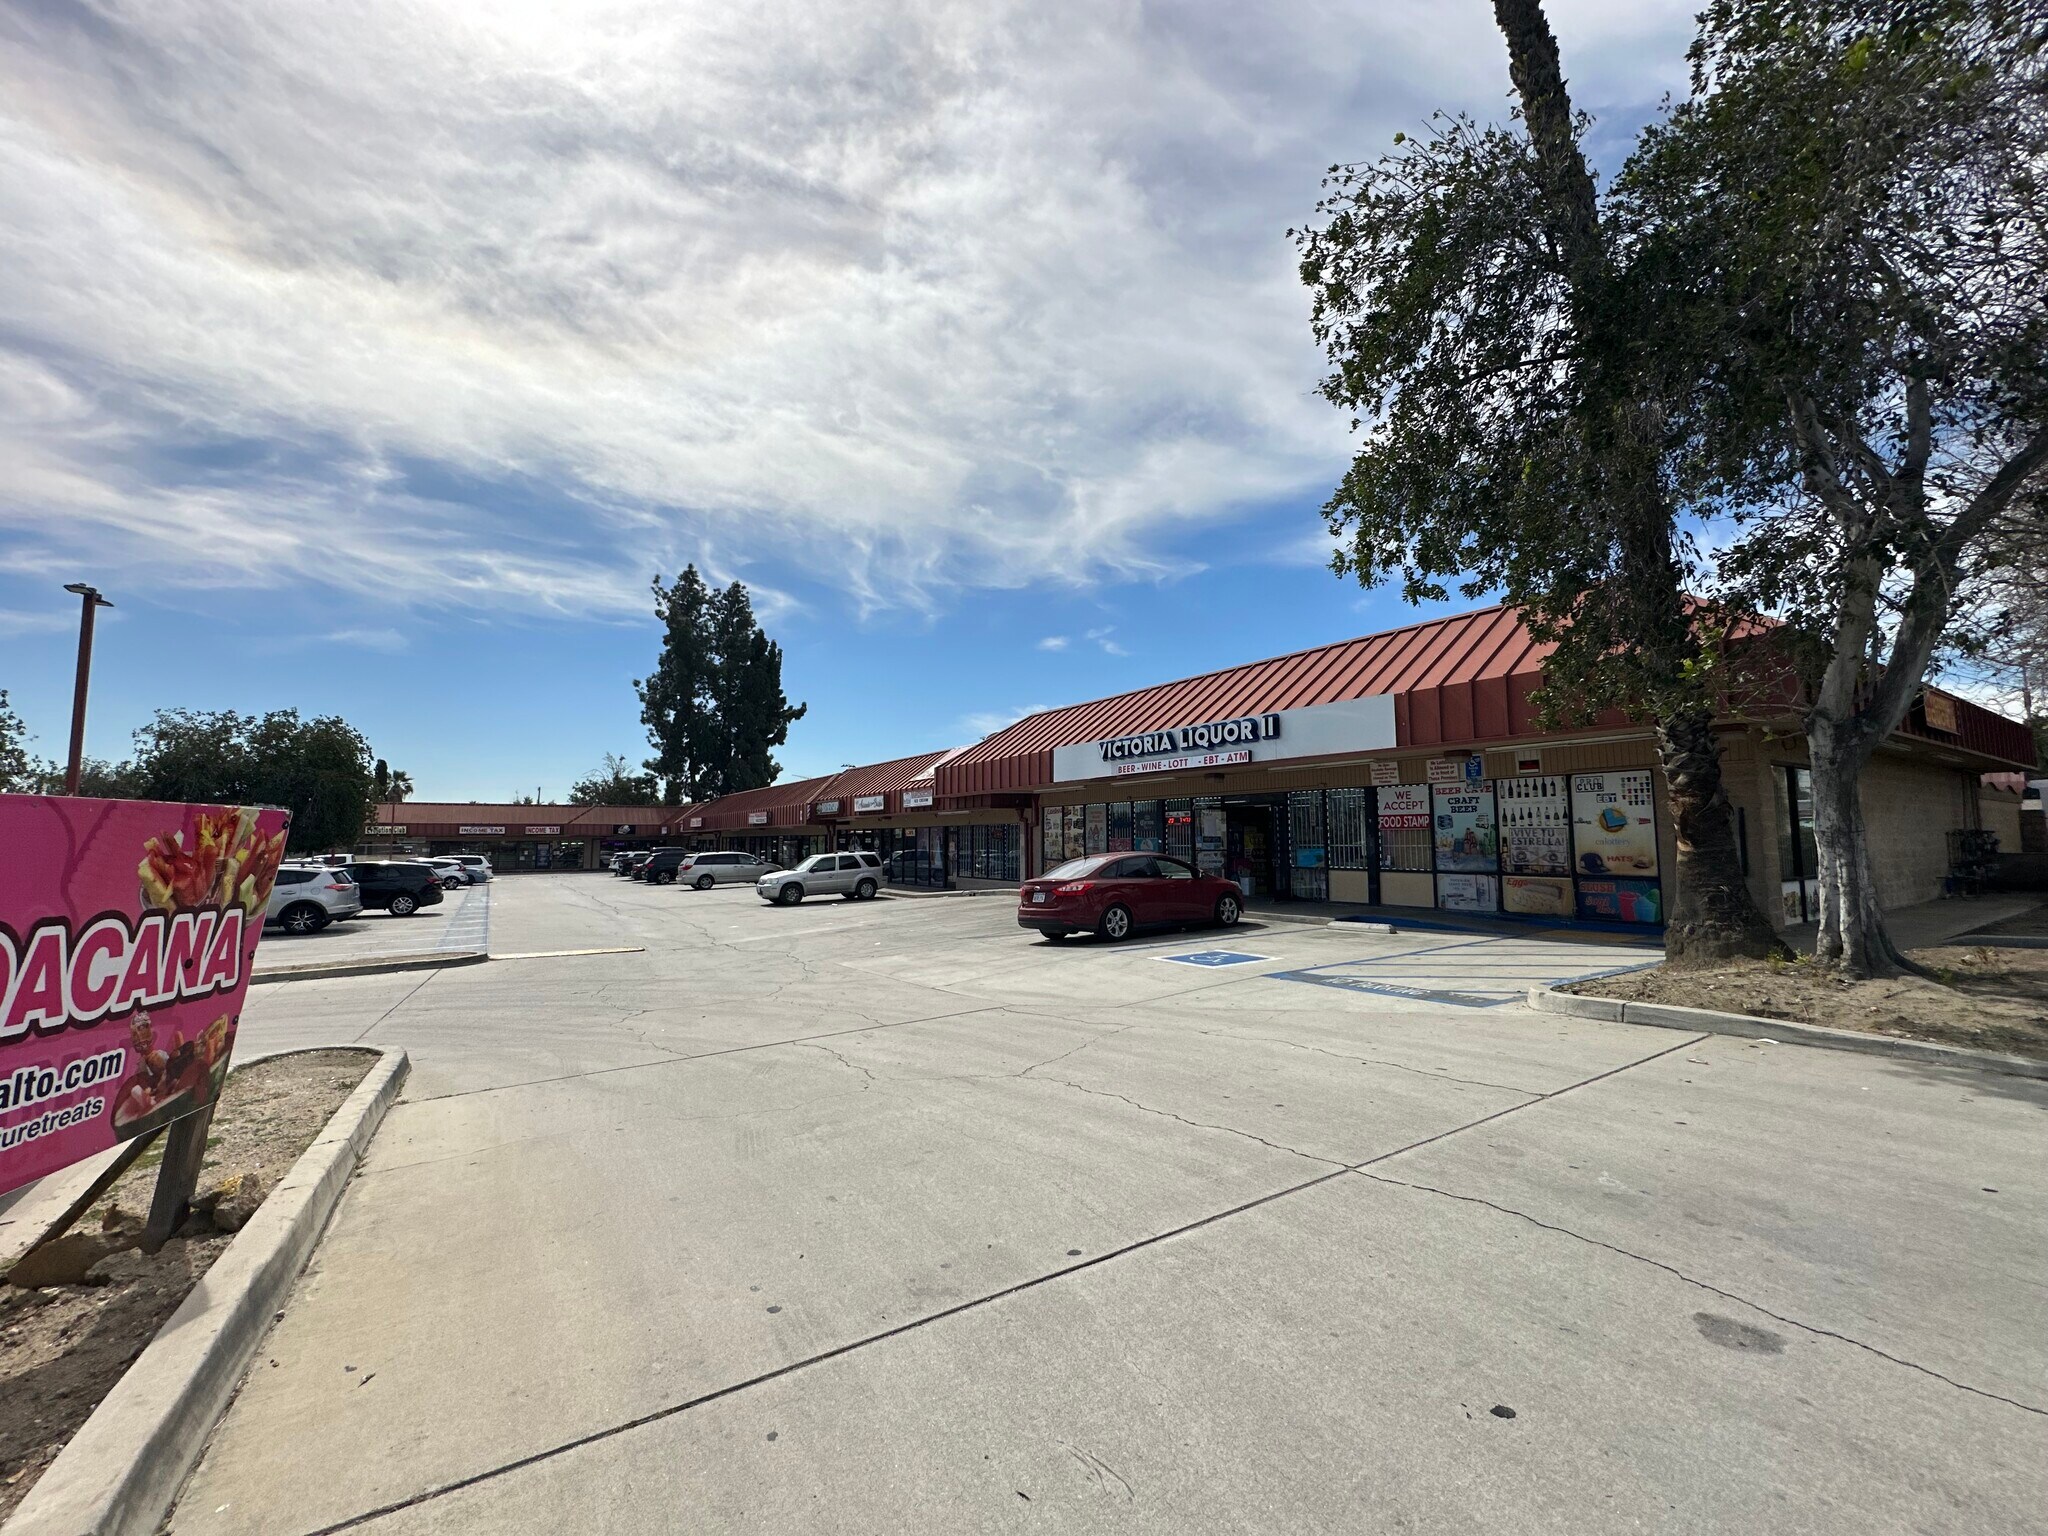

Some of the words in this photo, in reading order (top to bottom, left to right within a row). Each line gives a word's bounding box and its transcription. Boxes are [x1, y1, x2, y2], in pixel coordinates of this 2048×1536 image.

[1098, 732, 1175, 760] VICTORIA
[1180, 720, 1256, 749] LIQUOR
[1261, 715, 1277, 738] II
[1118, 766, 1136, 774] BEER
[1141, 762, 1162, 771] WINE
[1203, 755, 1219, 765] EBT
[1227, 751, 1247, 762] ATM
[1435, 787, 1461, 795] BEER
[1577, 783, 1604, 791] CLUB
[1395, 790, 1411, 800] WE
[1597, 794, 1616, 803] EBT
[1383, 801, 1424, 810] ACCEPT
[1379, 816, 1401, 828] FOOD
[1403, 815, 1429, 827] STAMP
[1511, 837, 1565, 846] ESTRELLA!
[0, 1097, 103, 1148] uretreats
